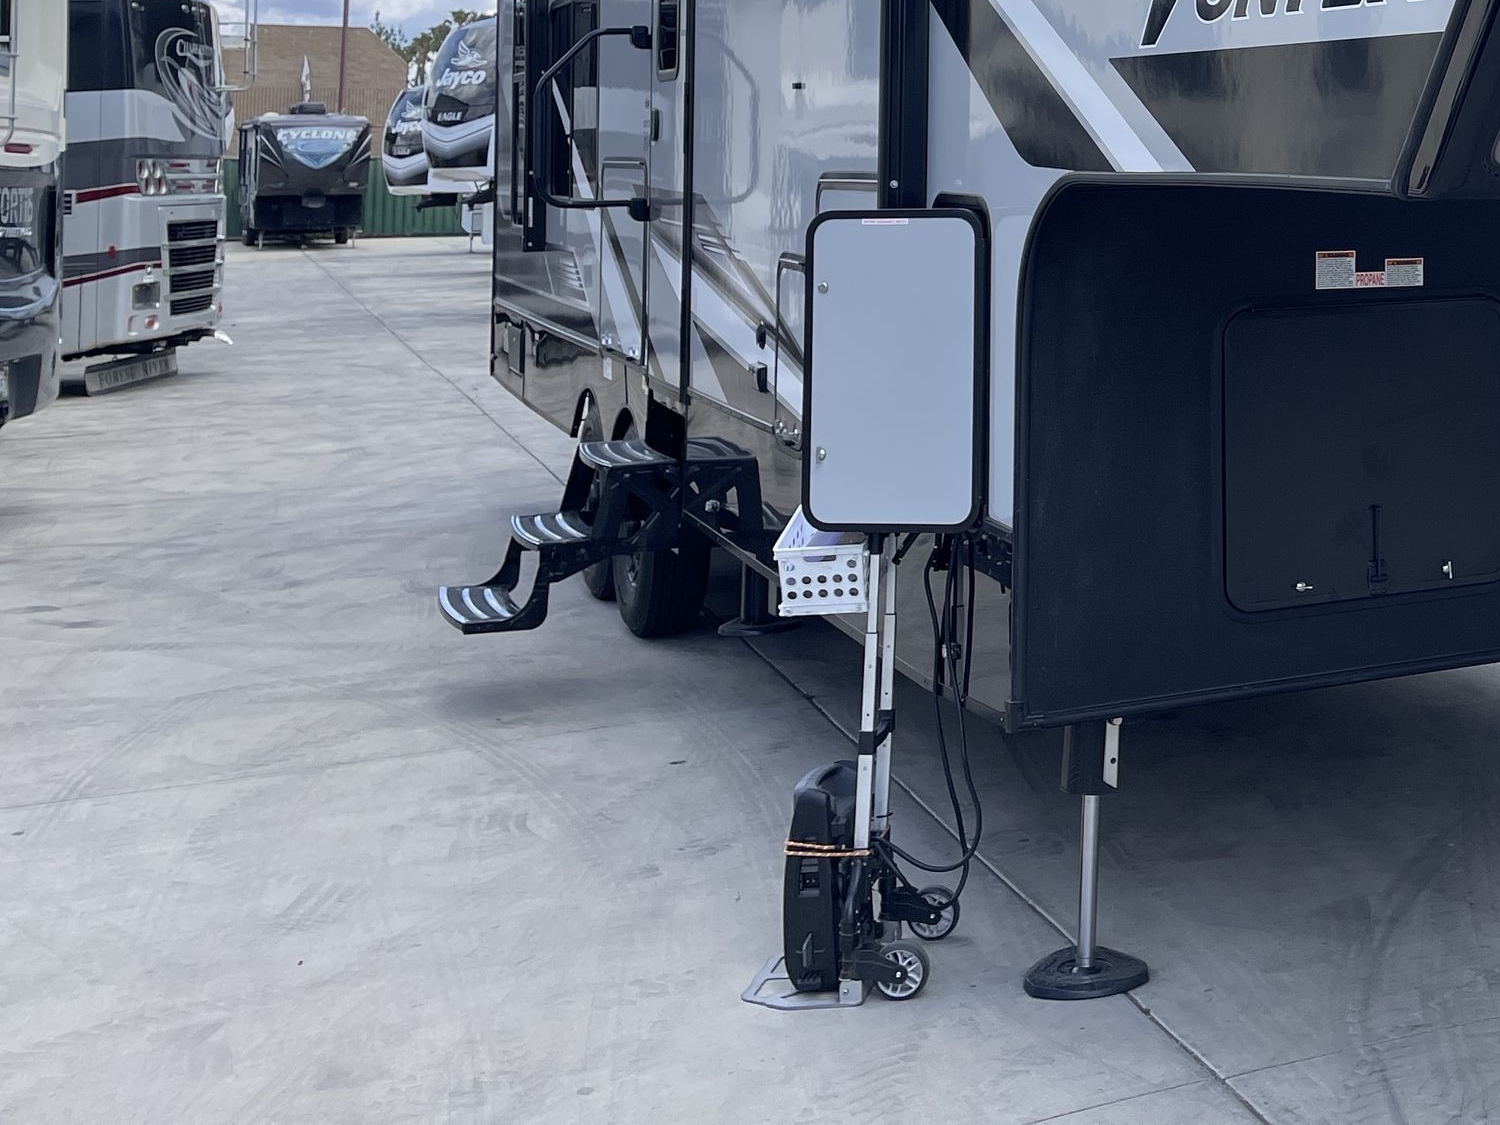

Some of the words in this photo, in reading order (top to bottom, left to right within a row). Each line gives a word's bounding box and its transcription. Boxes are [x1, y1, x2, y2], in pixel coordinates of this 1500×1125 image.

[436, 68, 486, 89] Jayco
[437, 112, 462, 122] EAGLE
[1356, 273, 1385, 286] PROPANE
